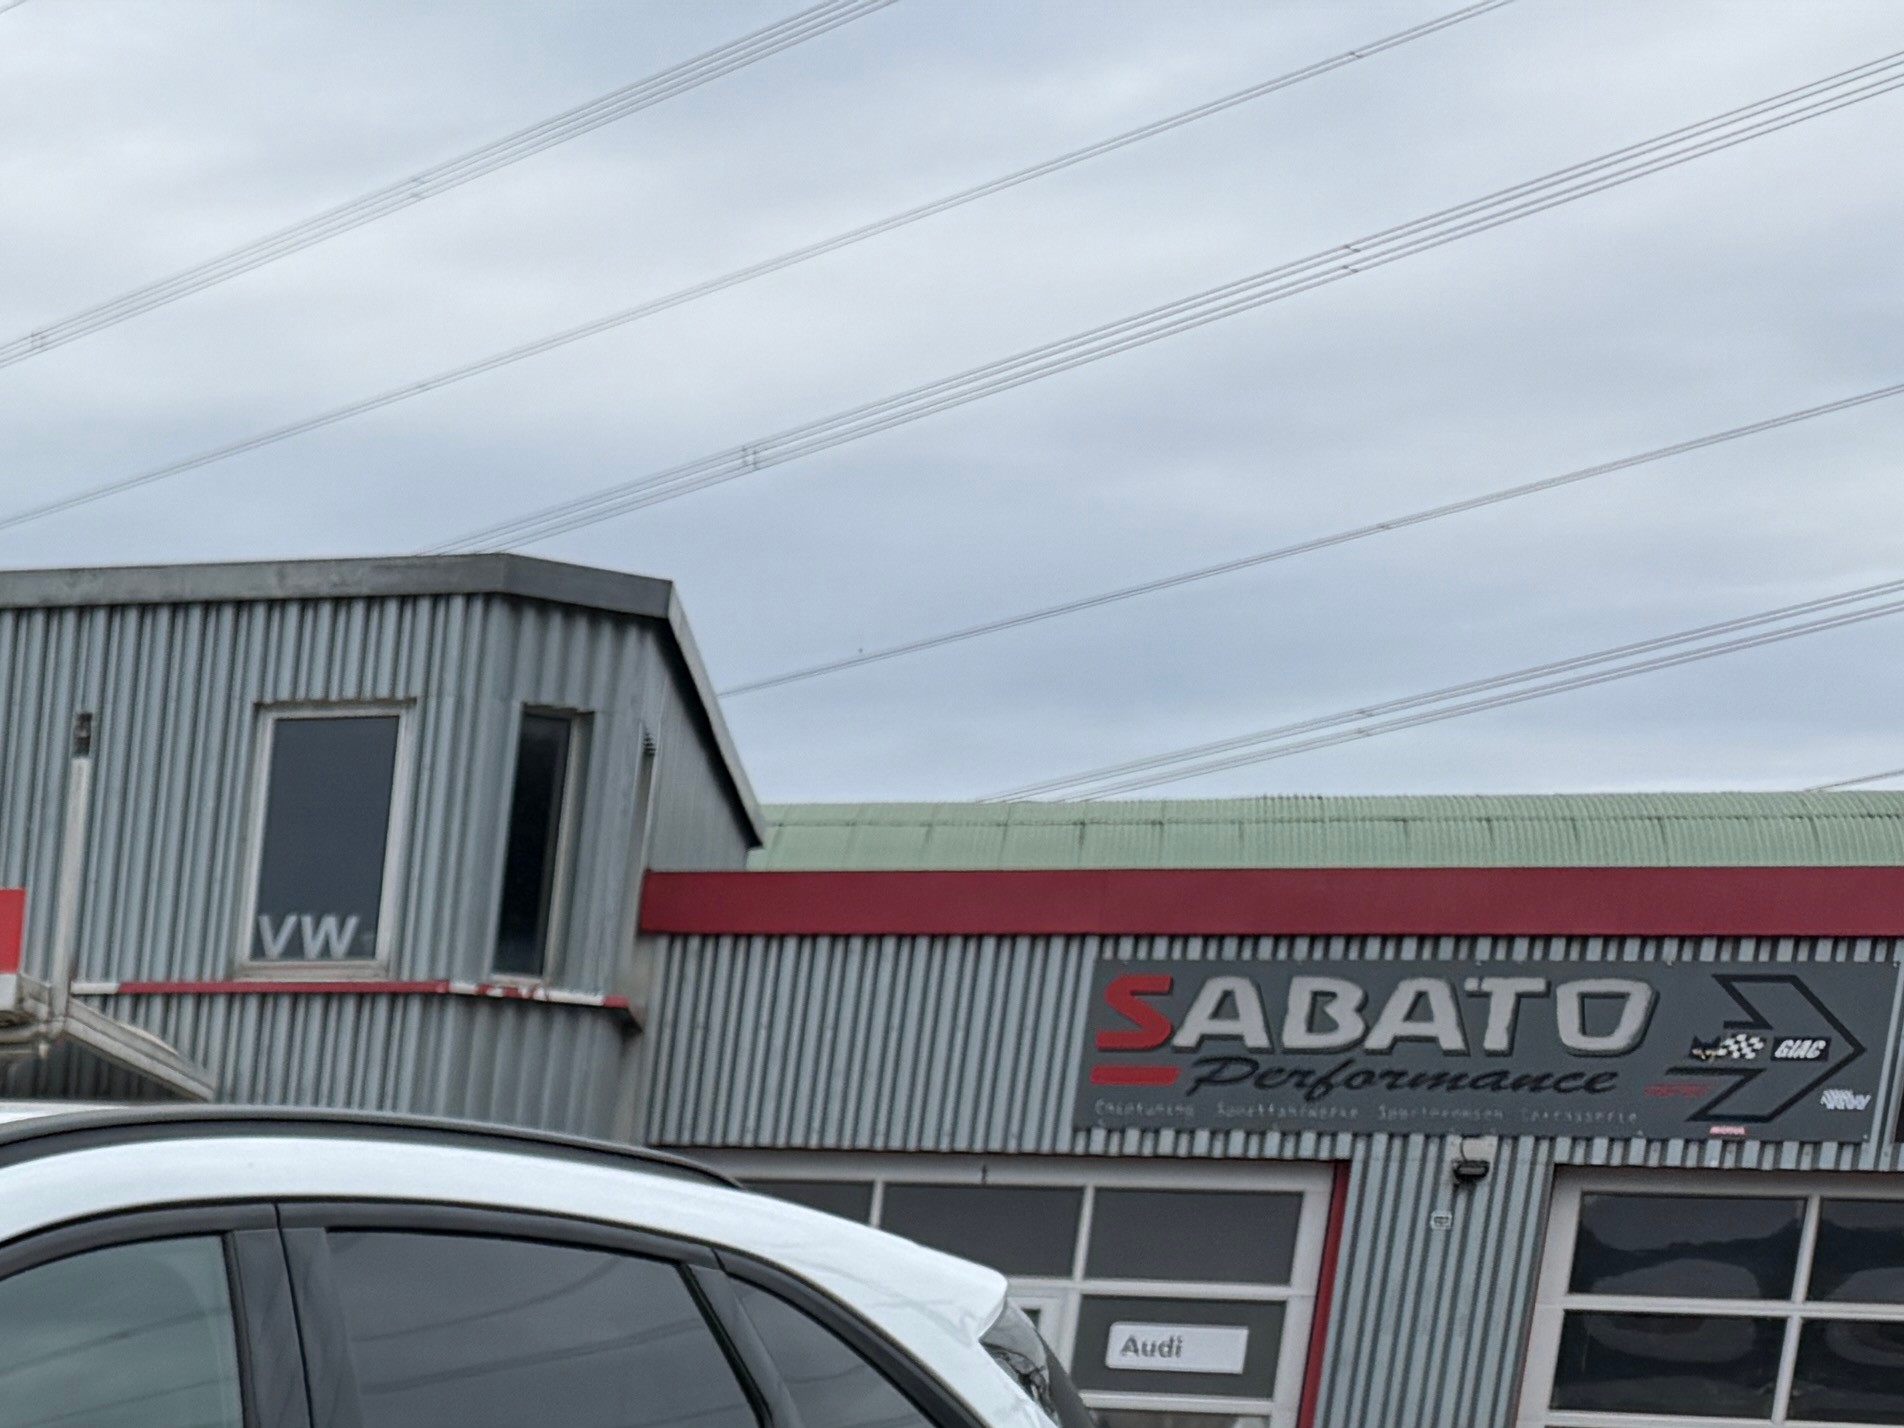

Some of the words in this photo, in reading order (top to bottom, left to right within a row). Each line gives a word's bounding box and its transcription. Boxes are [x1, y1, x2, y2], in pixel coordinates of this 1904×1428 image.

[258, 913, 359, 959] VW
[1094, 972, 1656, 1055] SABATO
[1774, 1040, 1827, 1060] GIAC
[1185, 1056, 1619, 1102] Performance
[1120, 1335, 1183, 1358] Audi
